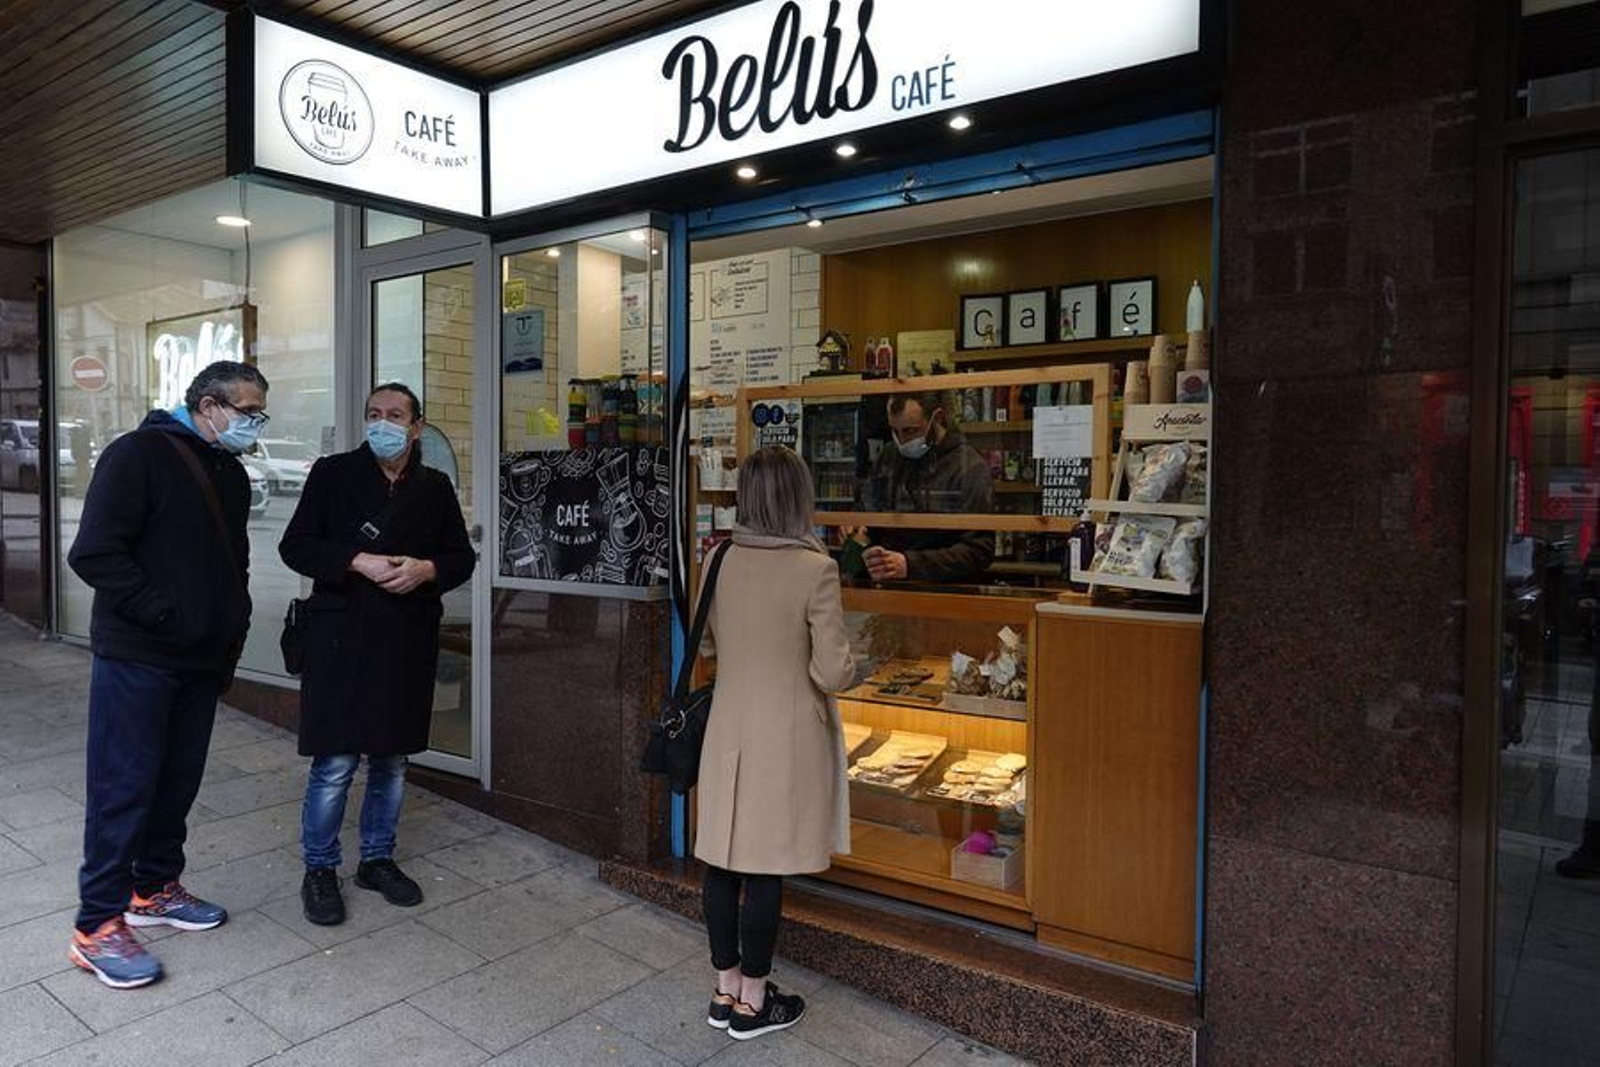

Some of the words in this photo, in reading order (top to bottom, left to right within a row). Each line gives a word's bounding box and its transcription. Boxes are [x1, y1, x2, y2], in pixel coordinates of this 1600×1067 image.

[662, 0, 878, 153] Belús
[891, 54, 956, 111] CAFÉ
[300, 95, 357, 132] Belús
[404, 110, 456, 147] CAFÉ
[394, 141, 428, 164] TAKE
[434, 156, 469, 168] AWAY
[556, 500, 590, 527] CAFÉ
[550, 528, 571, 545] TAKE
[573, 530, 597, 545] AWAY
